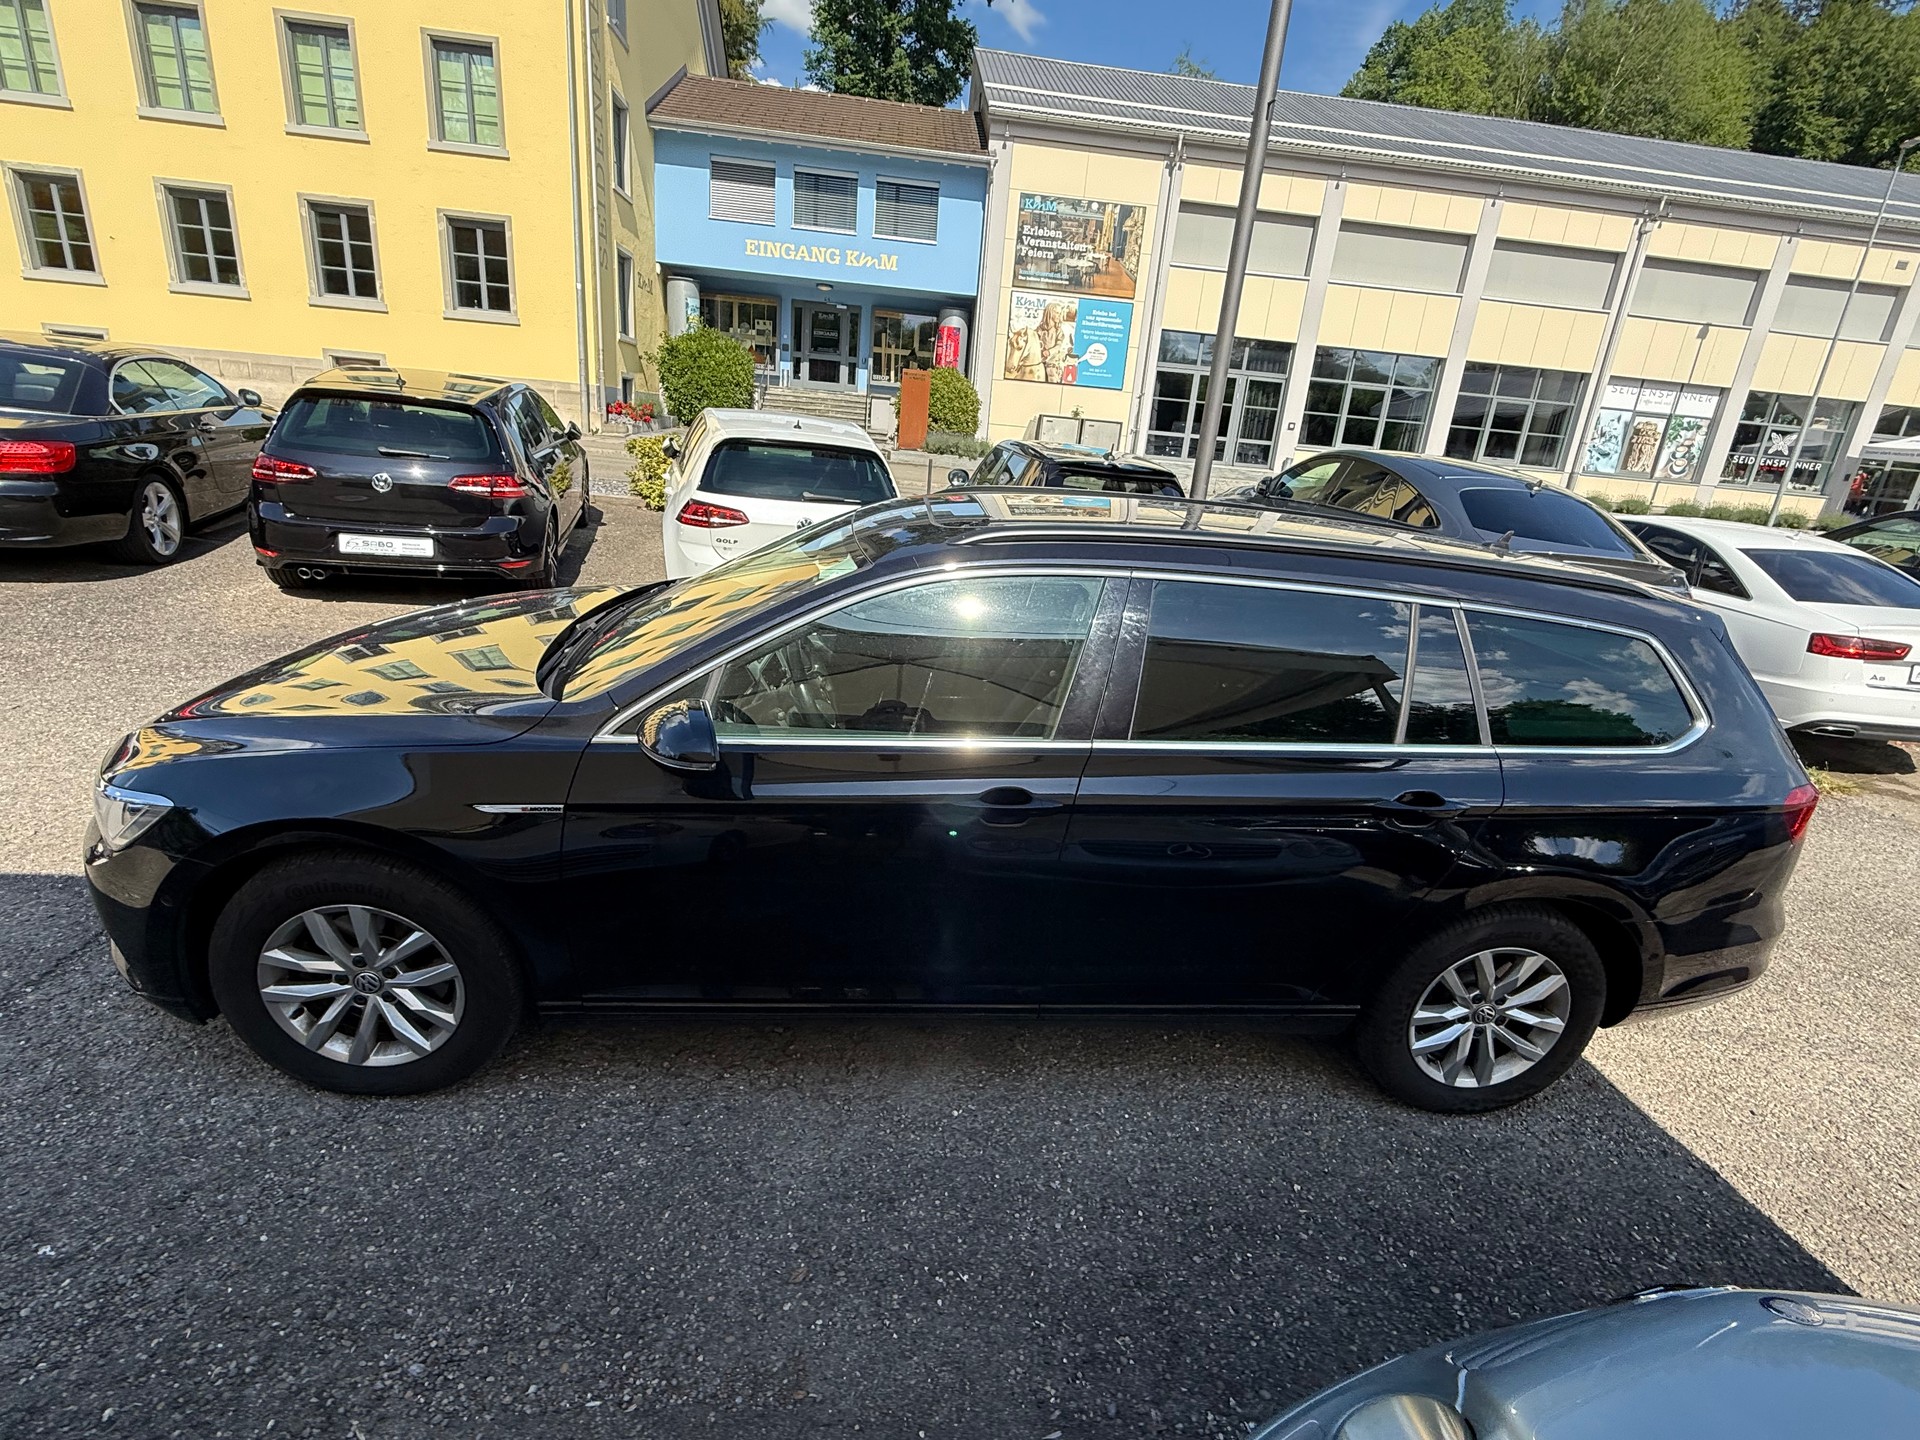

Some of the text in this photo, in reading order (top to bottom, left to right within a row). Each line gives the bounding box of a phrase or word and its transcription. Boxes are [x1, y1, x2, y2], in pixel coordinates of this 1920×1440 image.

[1024, 198, 1057, 212] KmM
[1022, 224, 1063, 239] Erleben
[1021, 235, 1088, 252] Veranstalten
[745, 239, 899, 271] EINGANG KmM
[1020, 247, 1055, 260] Feiern
[1015, 296, 1048, 309] KmM
[1610, 385, 1714, 404] SEIDENSPNNER
[1731, 455, 1823, 471] SEIDENSPINNER
[362, 540, 394, 548] SABO
[716, 537, 738, 545] GOLF
